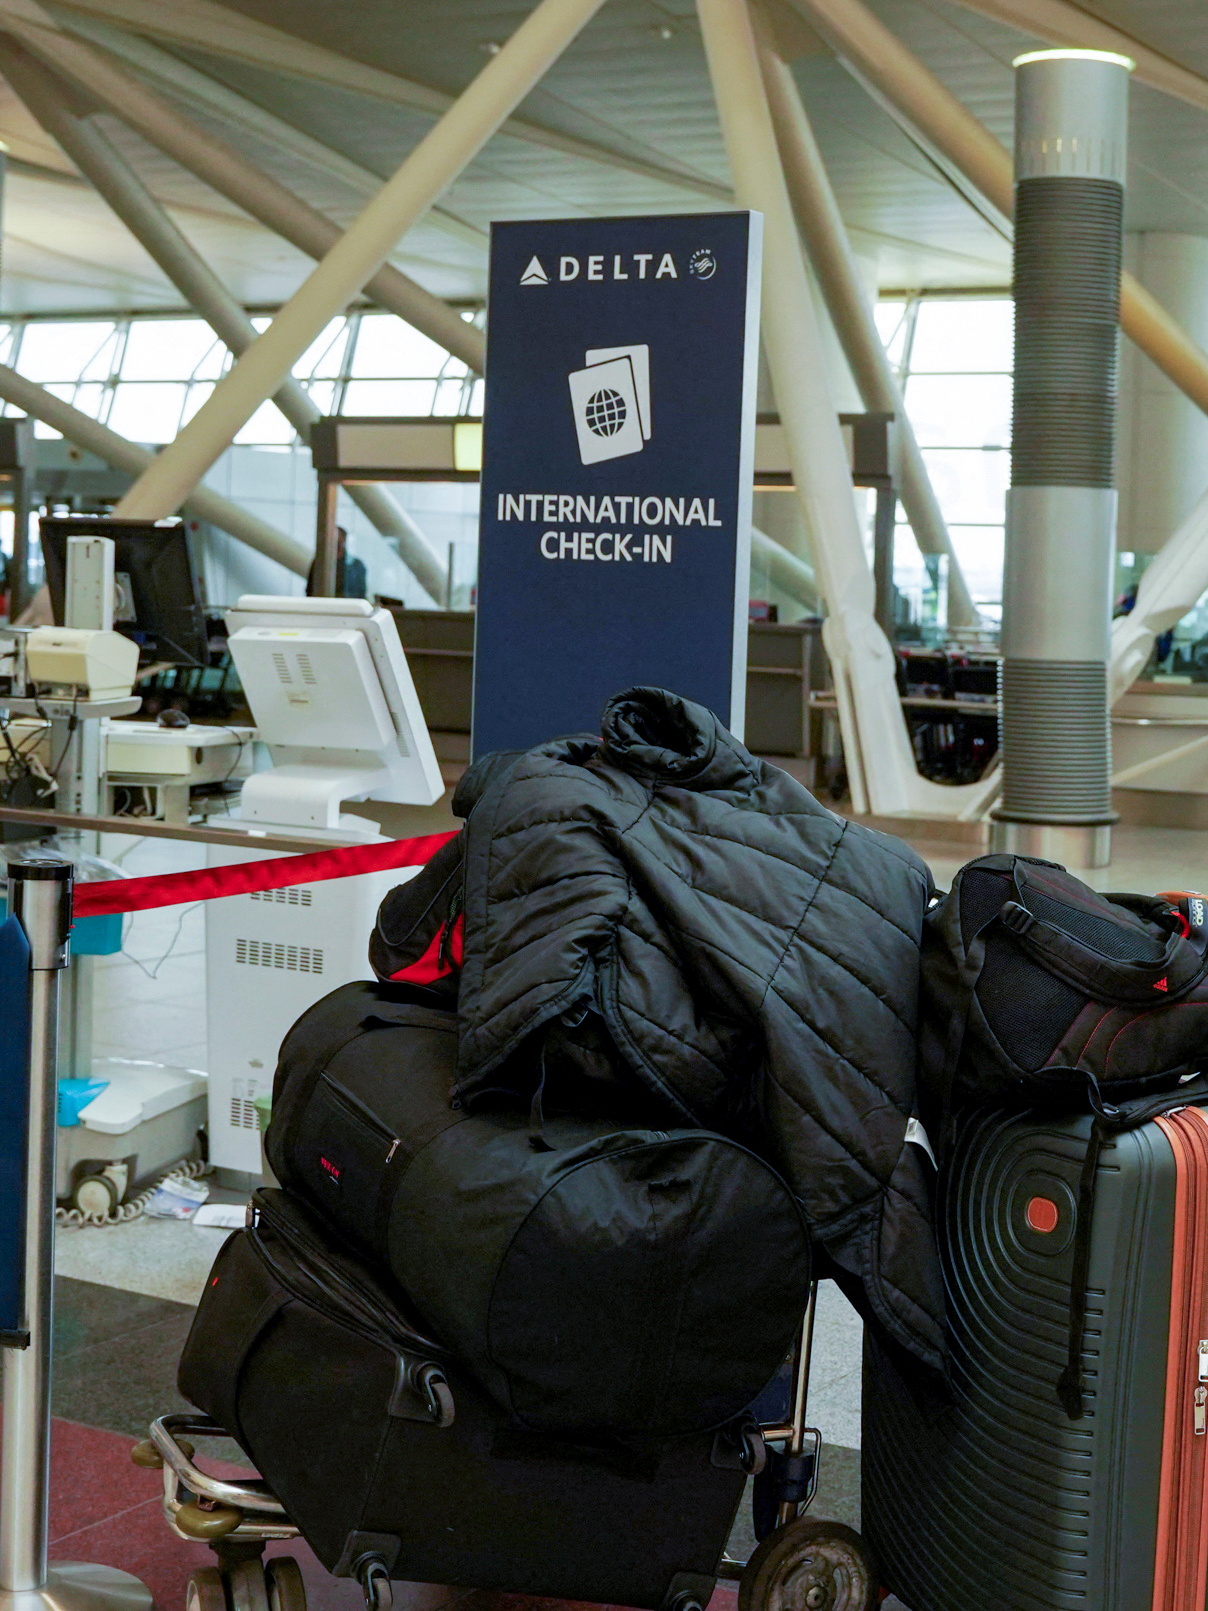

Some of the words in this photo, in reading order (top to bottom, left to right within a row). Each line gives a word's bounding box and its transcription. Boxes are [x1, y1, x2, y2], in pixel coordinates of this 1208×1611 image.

[560, 253, 678, 281] DELTA
[497, 494, 722, 527] INTERNATIONAL
[540, 531, 672, 563] CHECK-IN
[1195, 898, 1204, 926] LOAD
